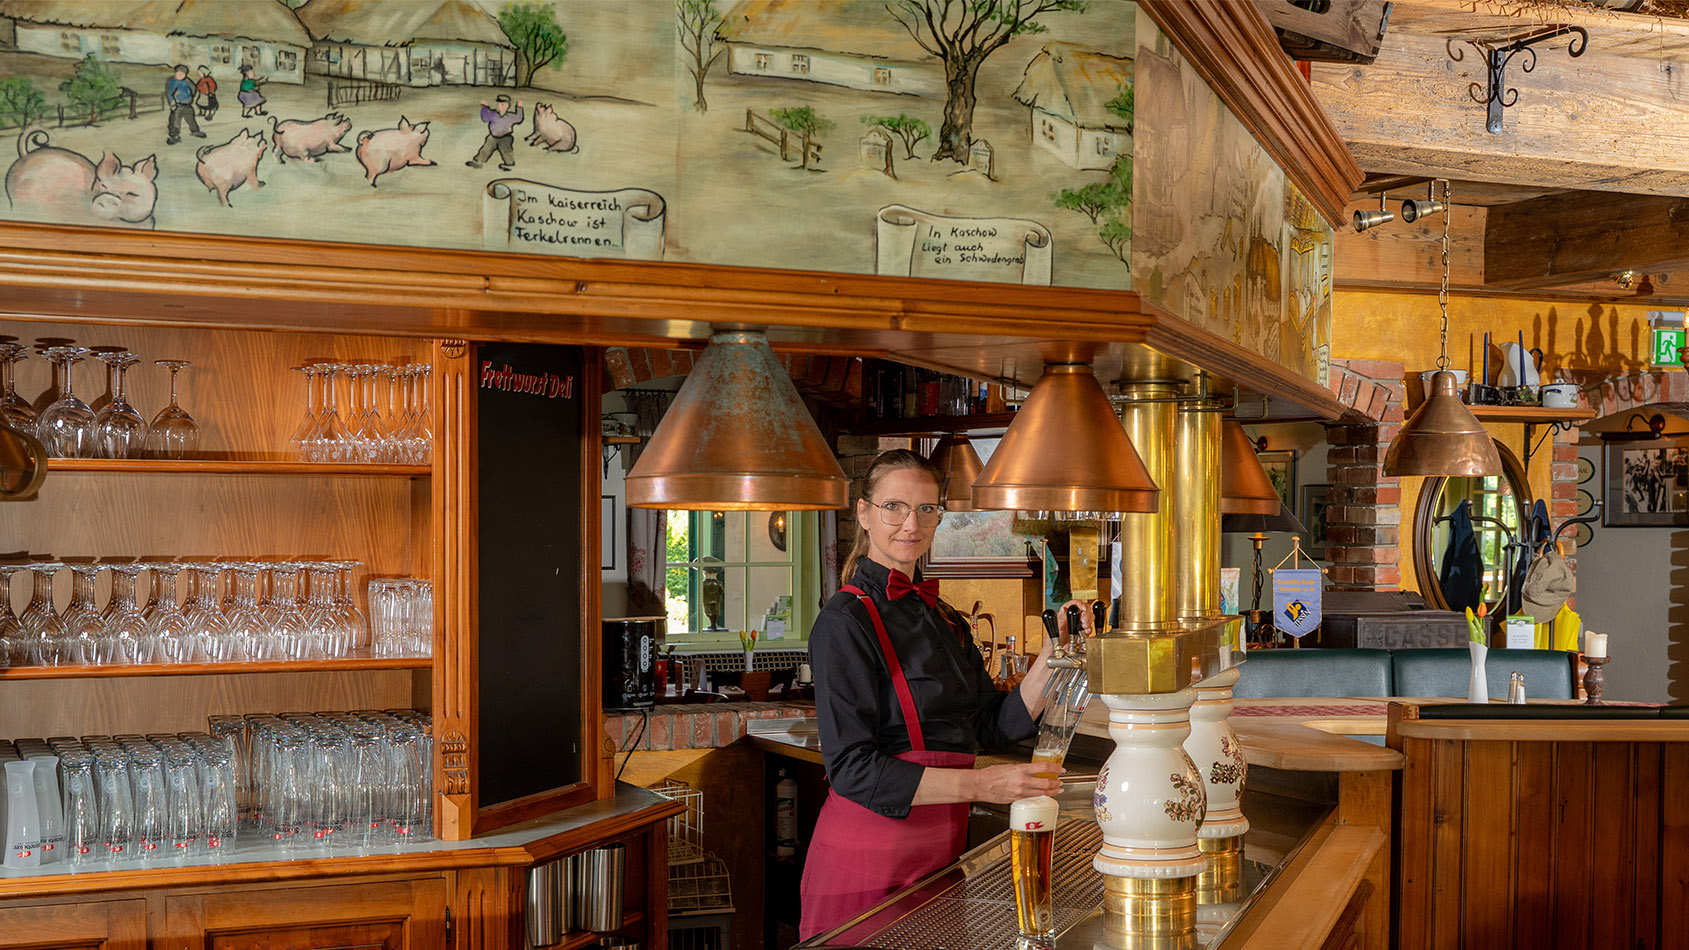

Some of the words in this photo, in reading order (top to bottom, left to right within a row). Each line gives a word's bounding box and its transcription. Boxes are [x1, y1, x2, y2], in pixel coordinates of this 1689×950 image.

[517, 209, 578, 227] Kaschow
[587, 216, 606, 230] ist
[928, 225, 942, 239] In
[950, 227, 998, 238] Kaschow
[954, 244, 984, 252] auch
[934, 256, 951, 265] ein
[959, 253, 1025, 266] Schwedengrab
[481, 360, 548, 395] Frettwurst
[548, 374, 574, 399] Deli
[1384, 625, 1469, 648] CASSE
